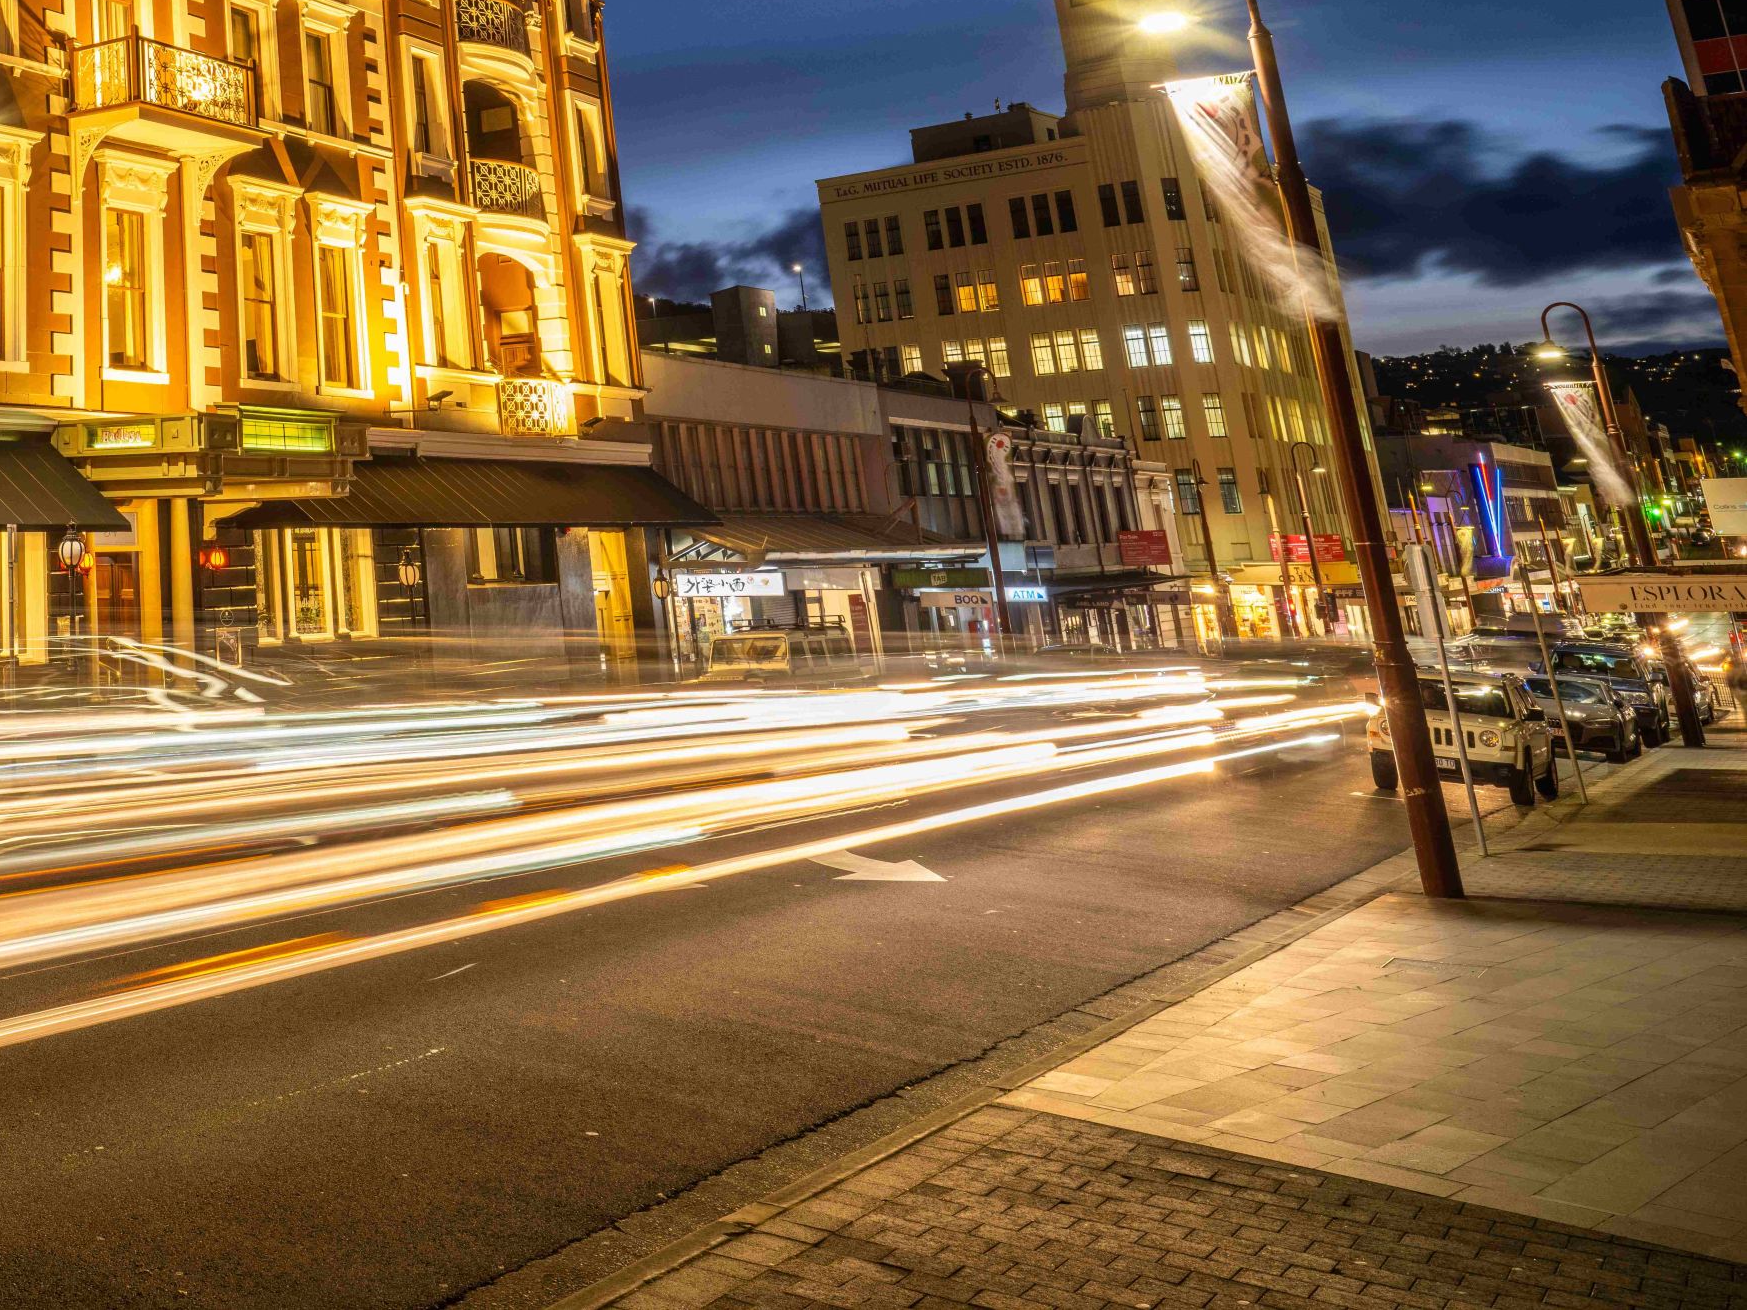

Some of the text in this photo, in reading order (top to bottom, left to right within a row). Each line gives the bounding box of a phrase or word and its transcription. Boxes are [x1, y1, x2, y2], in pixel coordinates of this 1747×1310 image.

[862, 177, 910, 195] MUTUAL
[913, 171, 939, 186] LIFE
[943, 164, 994, 180] SOCIETY
[997, 156, 1033, 172] ESTD.
[932, 574, 946, 582] TAB
[1013, 590, 1036, 599] ATM
[954, 595, 979, 604] BOQ
